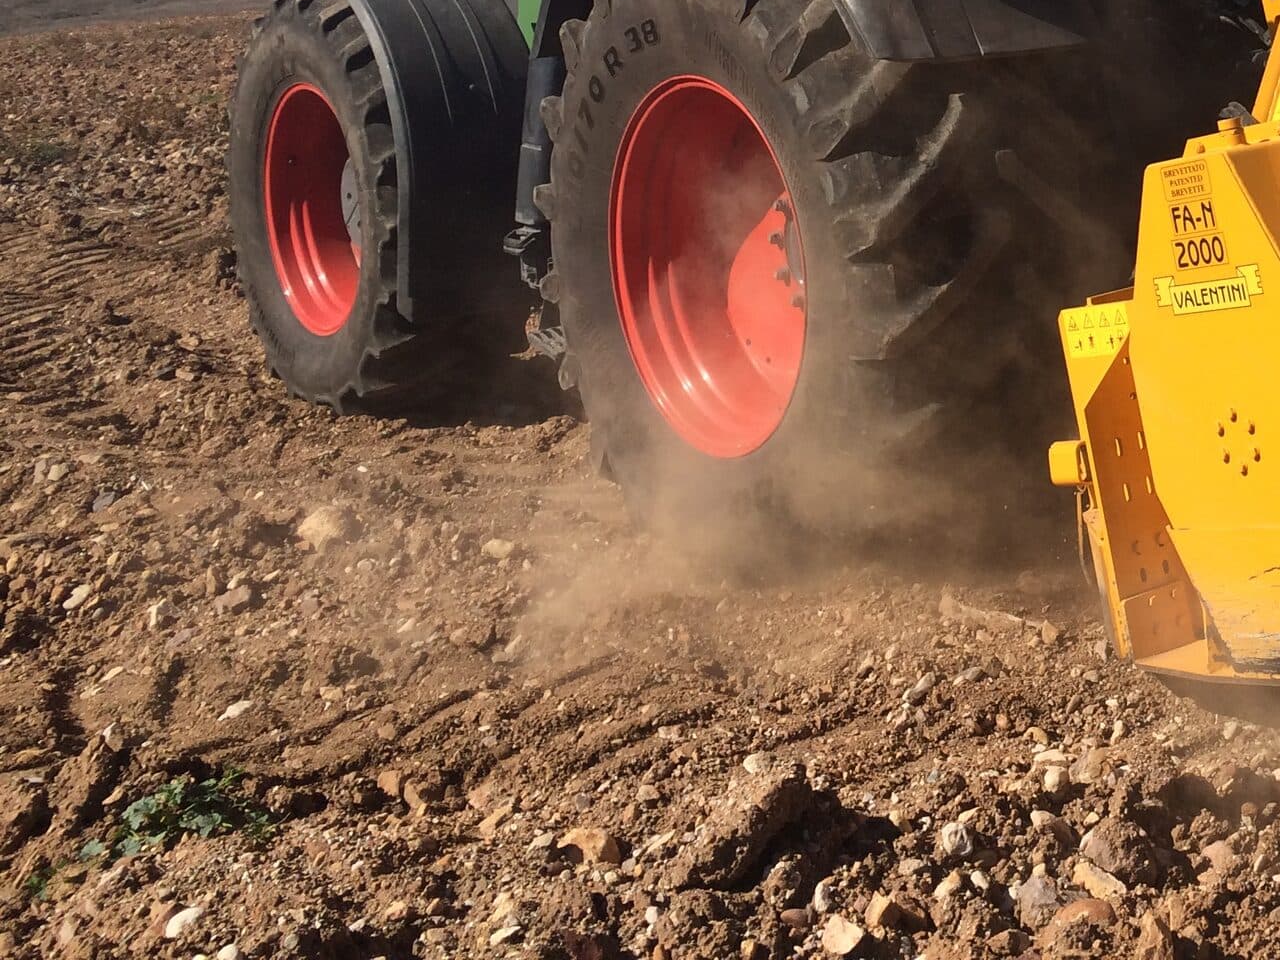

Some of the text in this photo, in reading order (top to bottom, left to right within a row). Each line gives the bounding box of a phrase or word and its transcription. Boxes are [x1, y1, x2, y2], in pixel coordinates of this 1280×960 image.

[603, 46, 624, 78] R
[624, 19, 659, 53] 38
[1163, 163, 1205, 178] BREVETTATO
[1169, 175, 1203, 186] PATENTED
[1171, 201, 1215, 233] FA-N
[1175, 236, 1224, 268] 2000
[1173, 283, 1247, 308] VALENTINI
